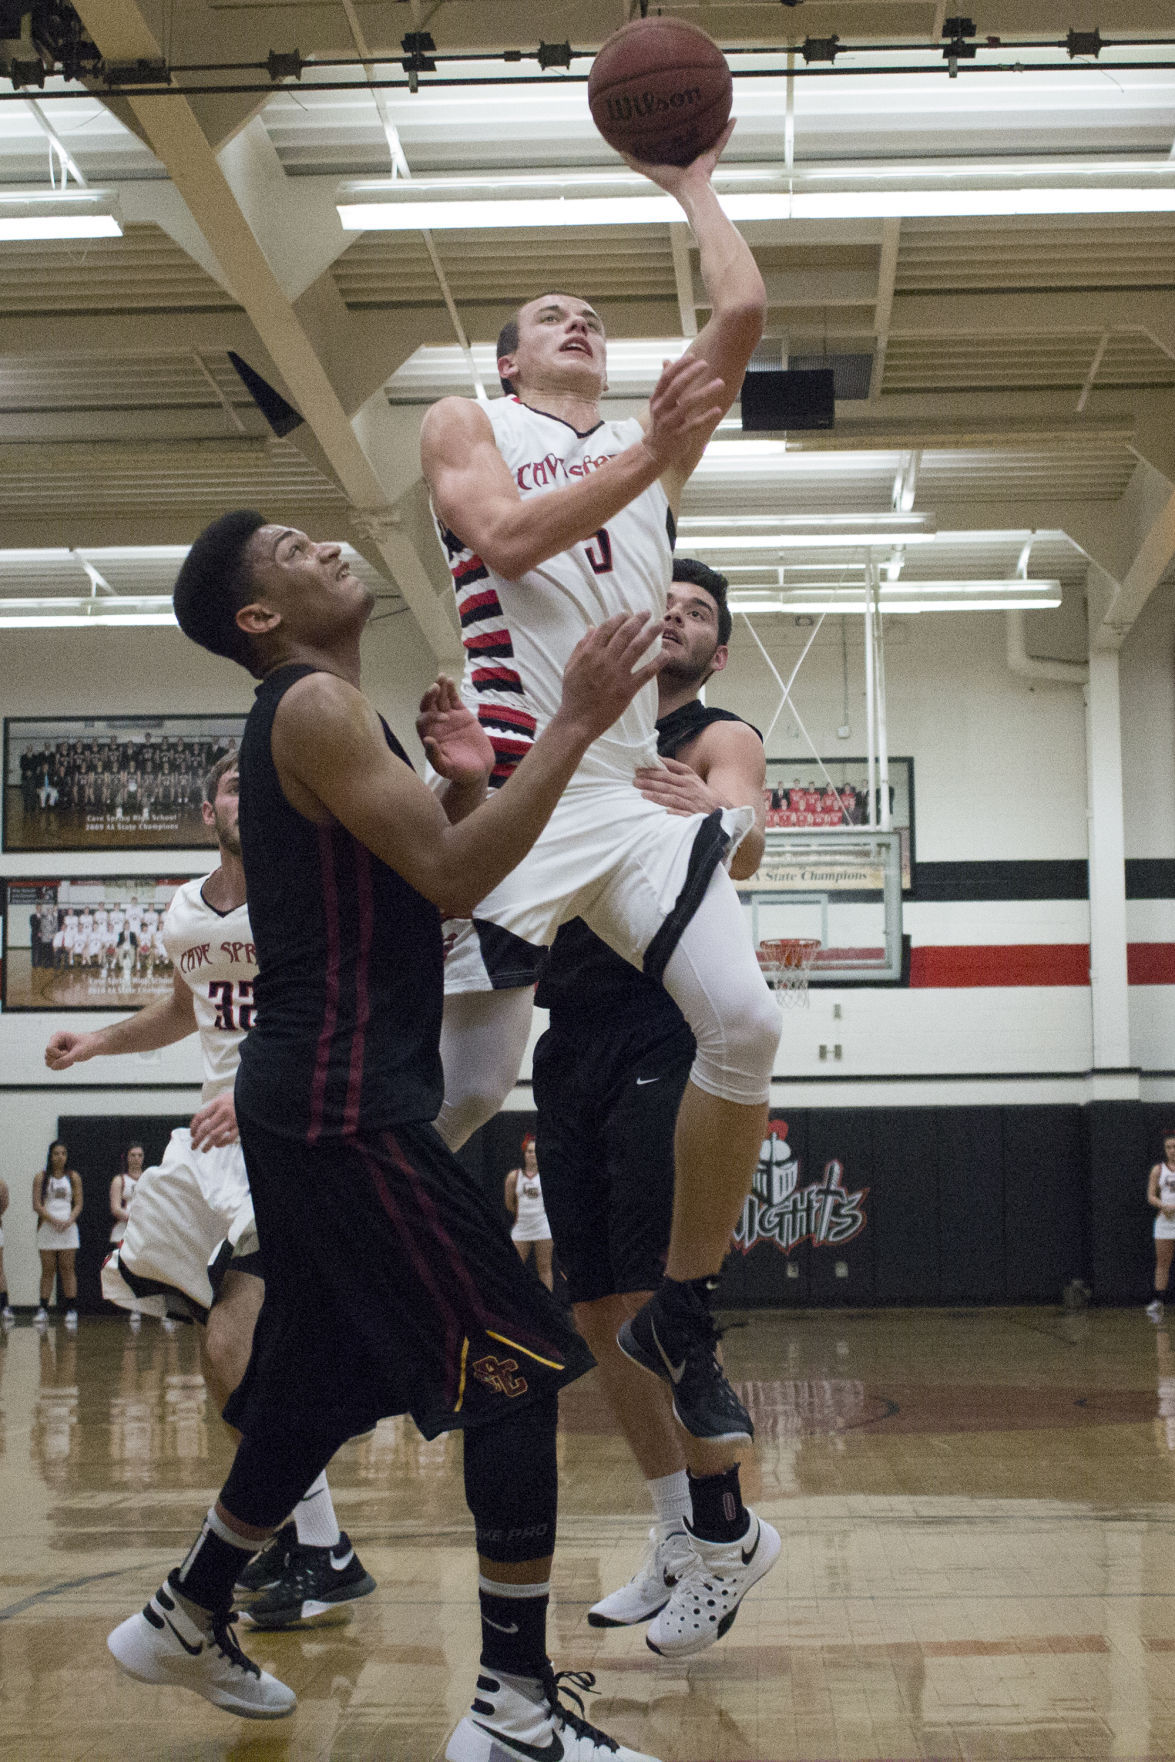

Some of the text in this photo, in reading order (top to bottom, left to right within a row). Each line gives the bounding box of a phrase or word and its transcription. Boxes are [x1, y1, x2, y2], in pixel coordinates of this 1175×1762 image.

[605, 87, 702, 120] Wilson
[766, 871, 797, 882] State
[801, 870, 868, 883] Champions
[180, 943, 213, 974] CAVE
